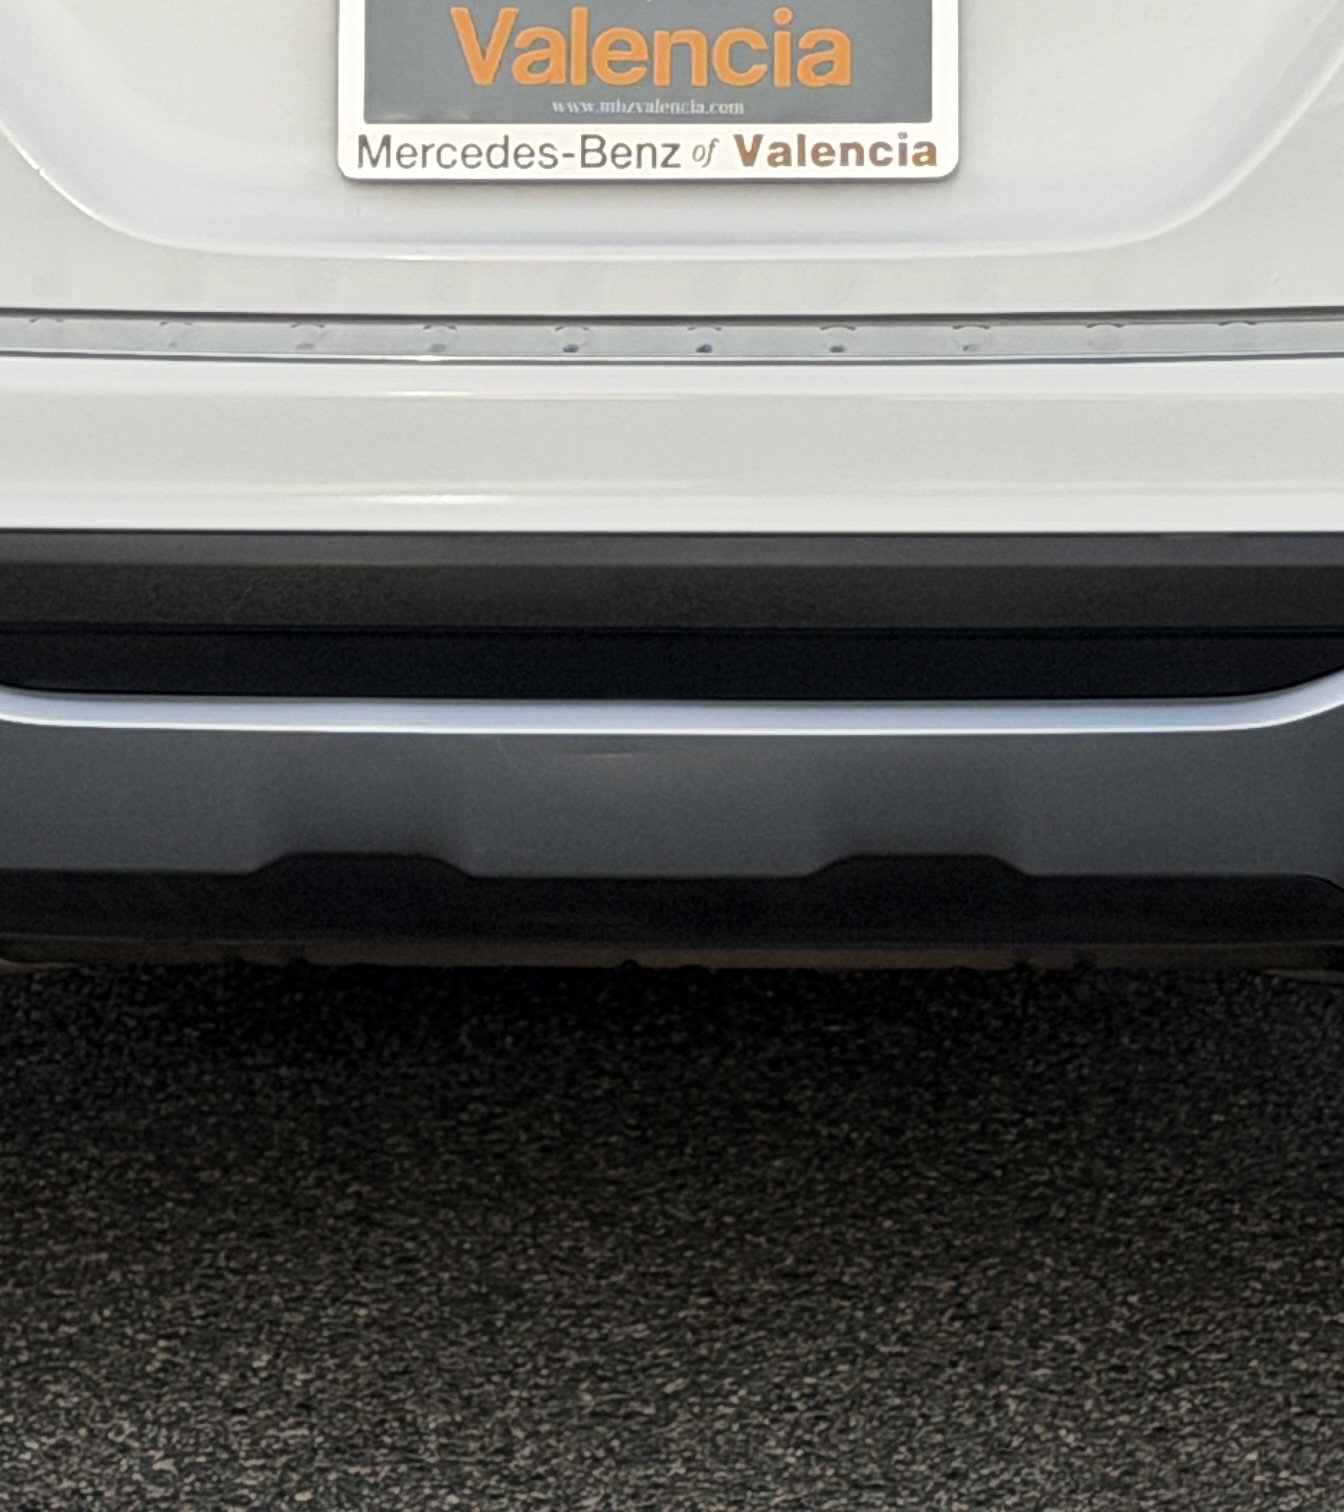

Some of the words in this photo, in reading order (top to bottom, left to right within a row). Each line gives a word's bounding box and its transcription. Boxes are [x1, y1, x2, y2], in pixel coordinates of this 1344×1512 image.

[450, 6, 853, 88] Valencia
[357, 134, 682, 169] Mercedes-Benz
[691, 137, 720, 168] of
[733, 131, 938, 168] Valencia
